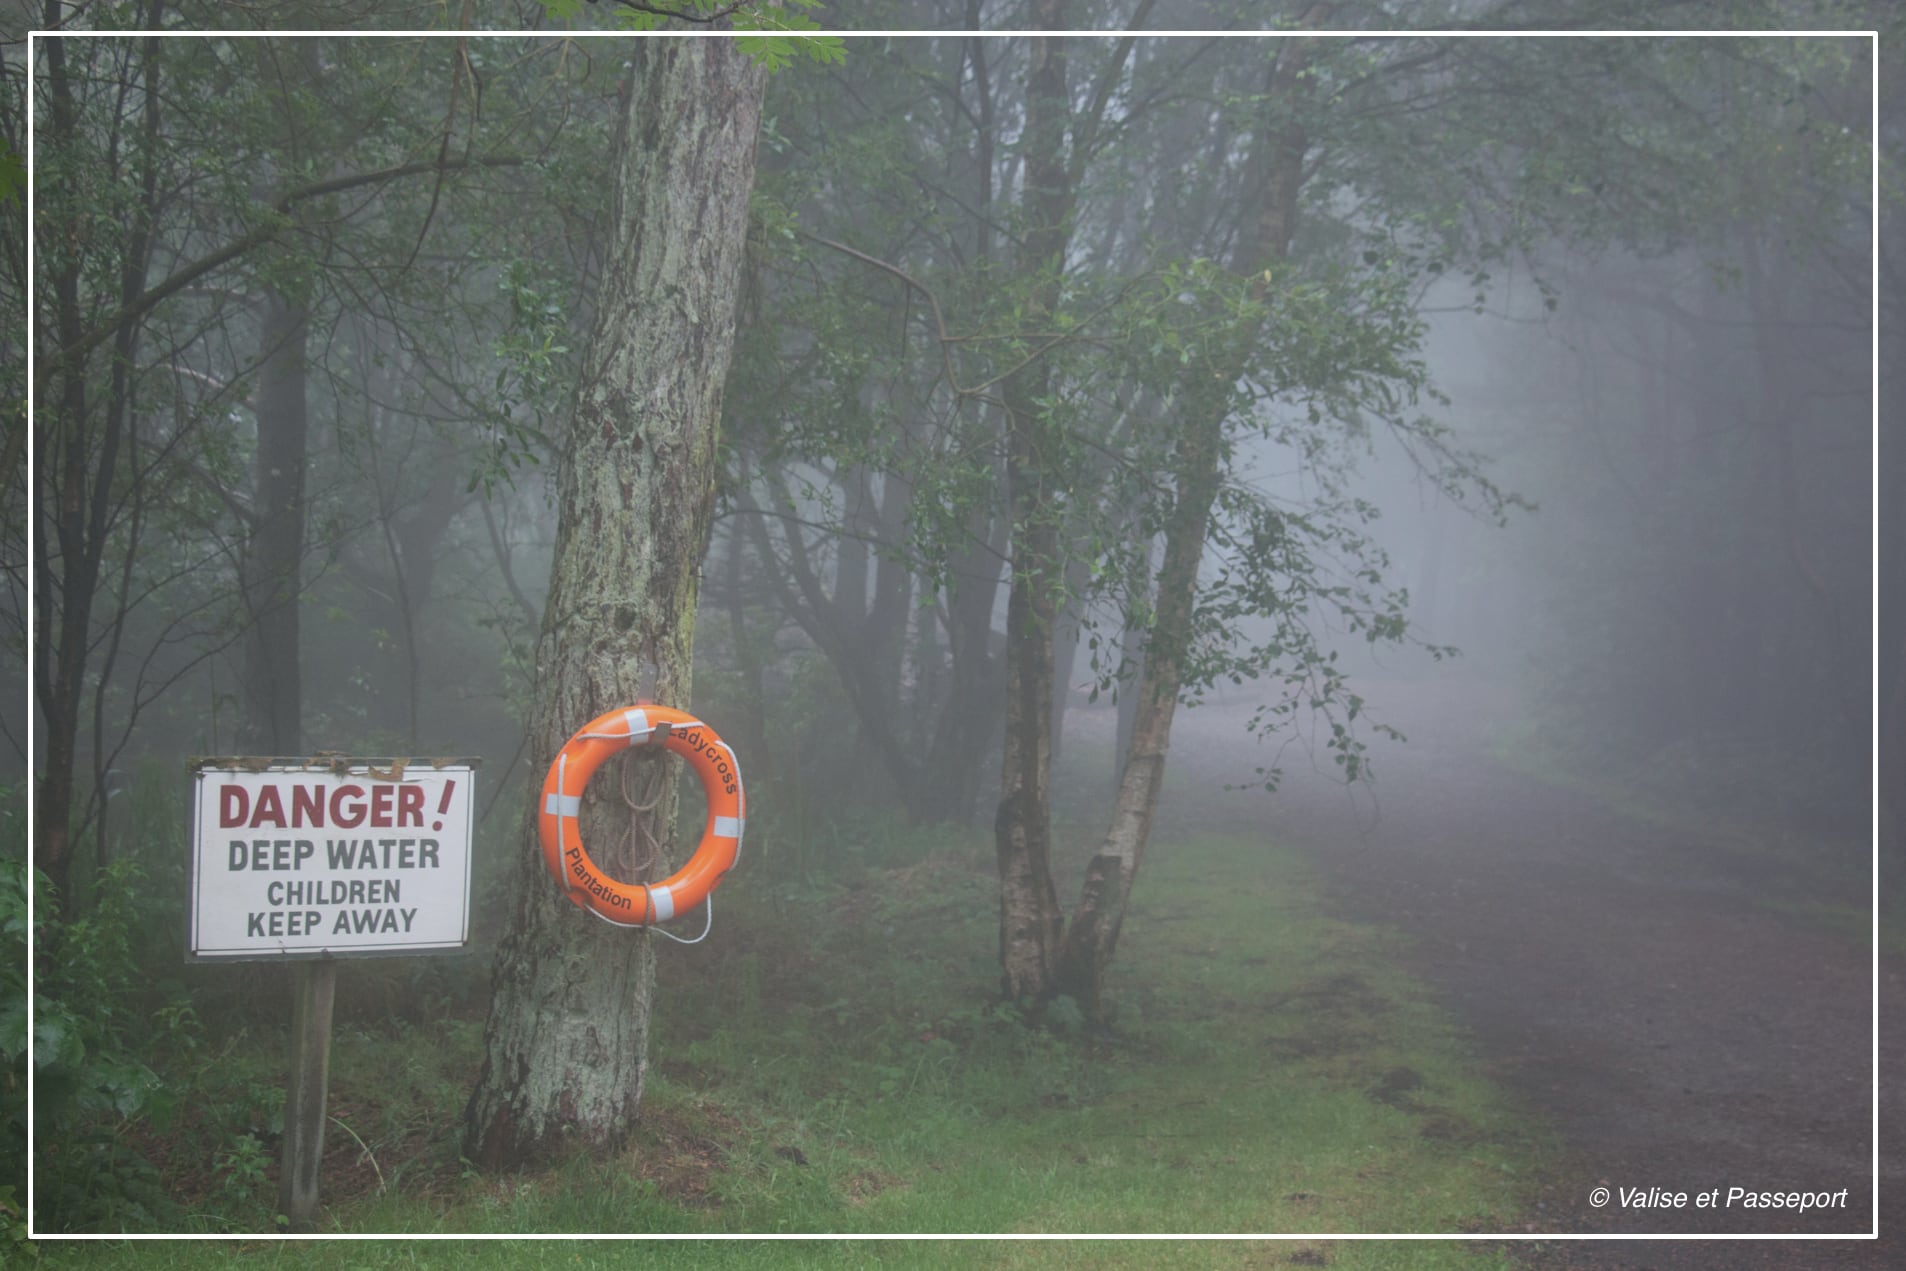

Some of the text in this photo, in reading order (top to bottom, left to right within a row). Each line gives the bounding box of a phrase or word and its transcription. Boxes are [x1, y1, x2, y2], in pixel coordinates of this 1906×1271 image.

[219, 779, 456, 832] DANGER!
[228, 839, 440, 871] DEEP WATER
[267, 879, 400, 906] CHILDREN
[565, 847, 633, 910] Plantation
[247, 908, 417, 937] KEEP AWAY
